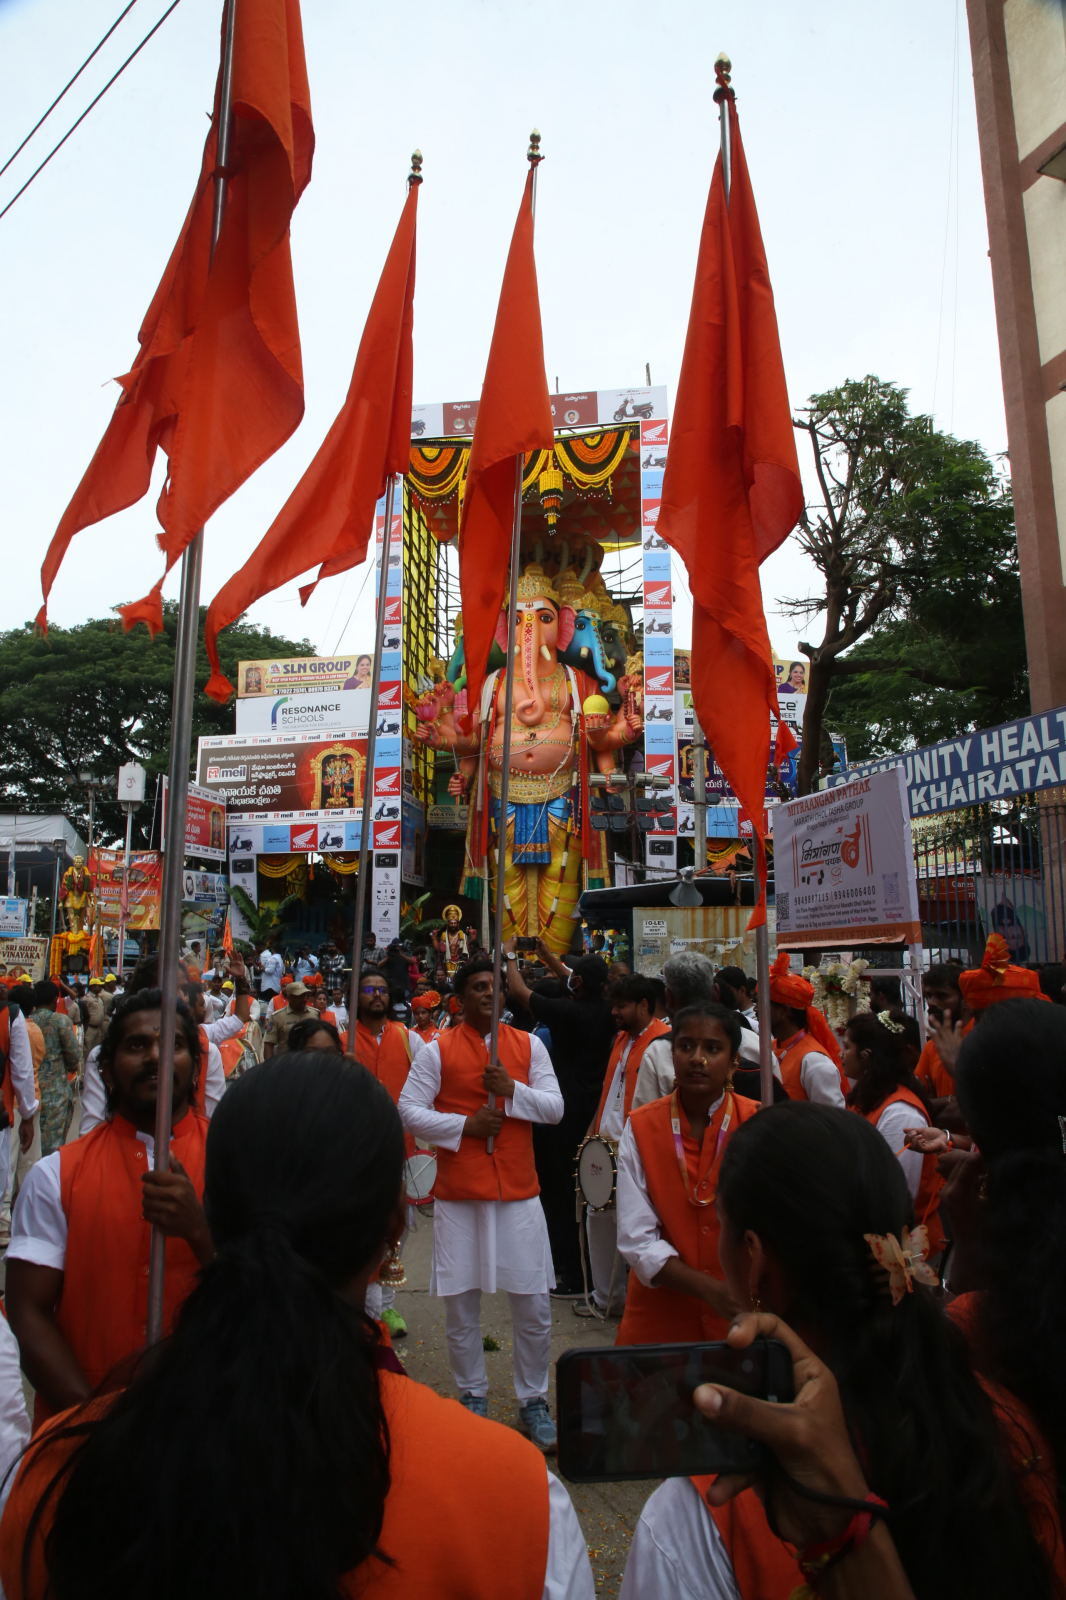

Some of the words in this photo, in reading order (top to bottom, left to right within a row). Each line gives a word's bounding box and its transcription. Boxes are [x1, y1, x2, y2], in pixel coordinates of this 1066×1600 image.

[283, 662, 307, 675] SLN
[309, 660, 352, 674] GROUP
[281, 703, 342, 716] RESONANCE
[281, 714, 325, 725] SCHOOLS
[221, 765, 246, 778] meil
[787, 790, 835, 817] MITRAANGAN
[835, 778, 872, 800] PATHAK
[19, 944, 38, 952] SIDDI
[2, 950, 41, 960] VINAYAKA
